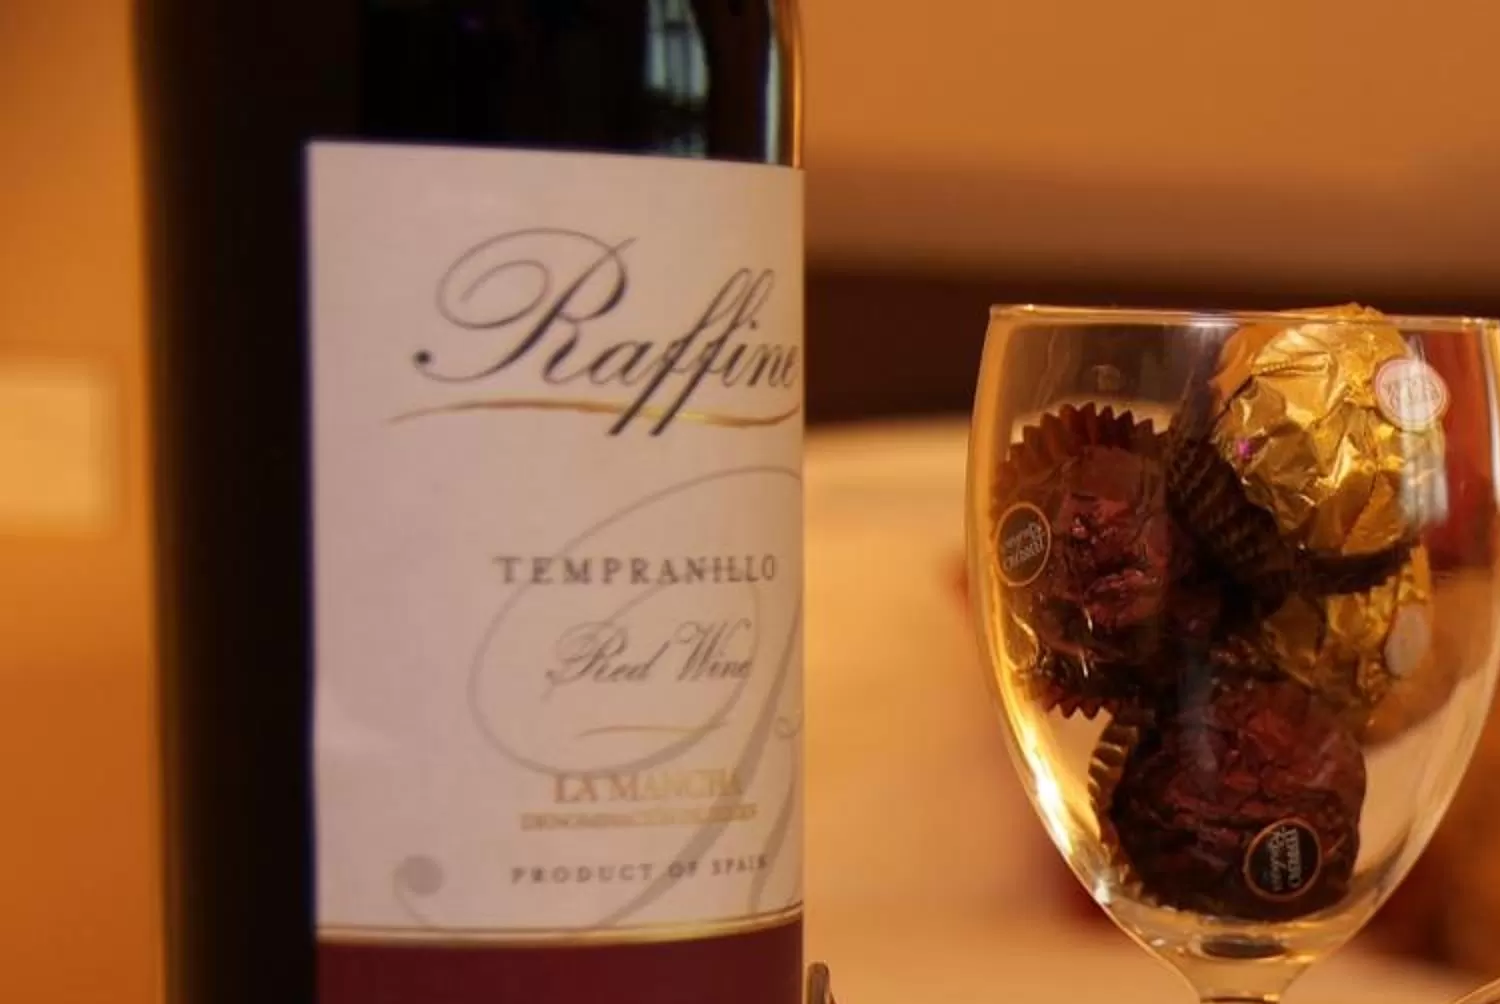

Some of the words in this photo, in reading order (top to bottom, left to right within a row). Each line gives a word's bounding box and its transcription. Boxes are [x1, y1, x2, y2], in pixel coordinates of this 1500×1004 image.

[495, 555, 777, 584] TEMPRANILLO
[545, 620, 670, 684] Red
[673, 618, 752, 682] Wine
[554, 773, 598, 804] LA
[511, 864, 654, 885] PRODUCT
[667, 860, 698, 879] OF
[711, 854, 768, 876] SPAIN
